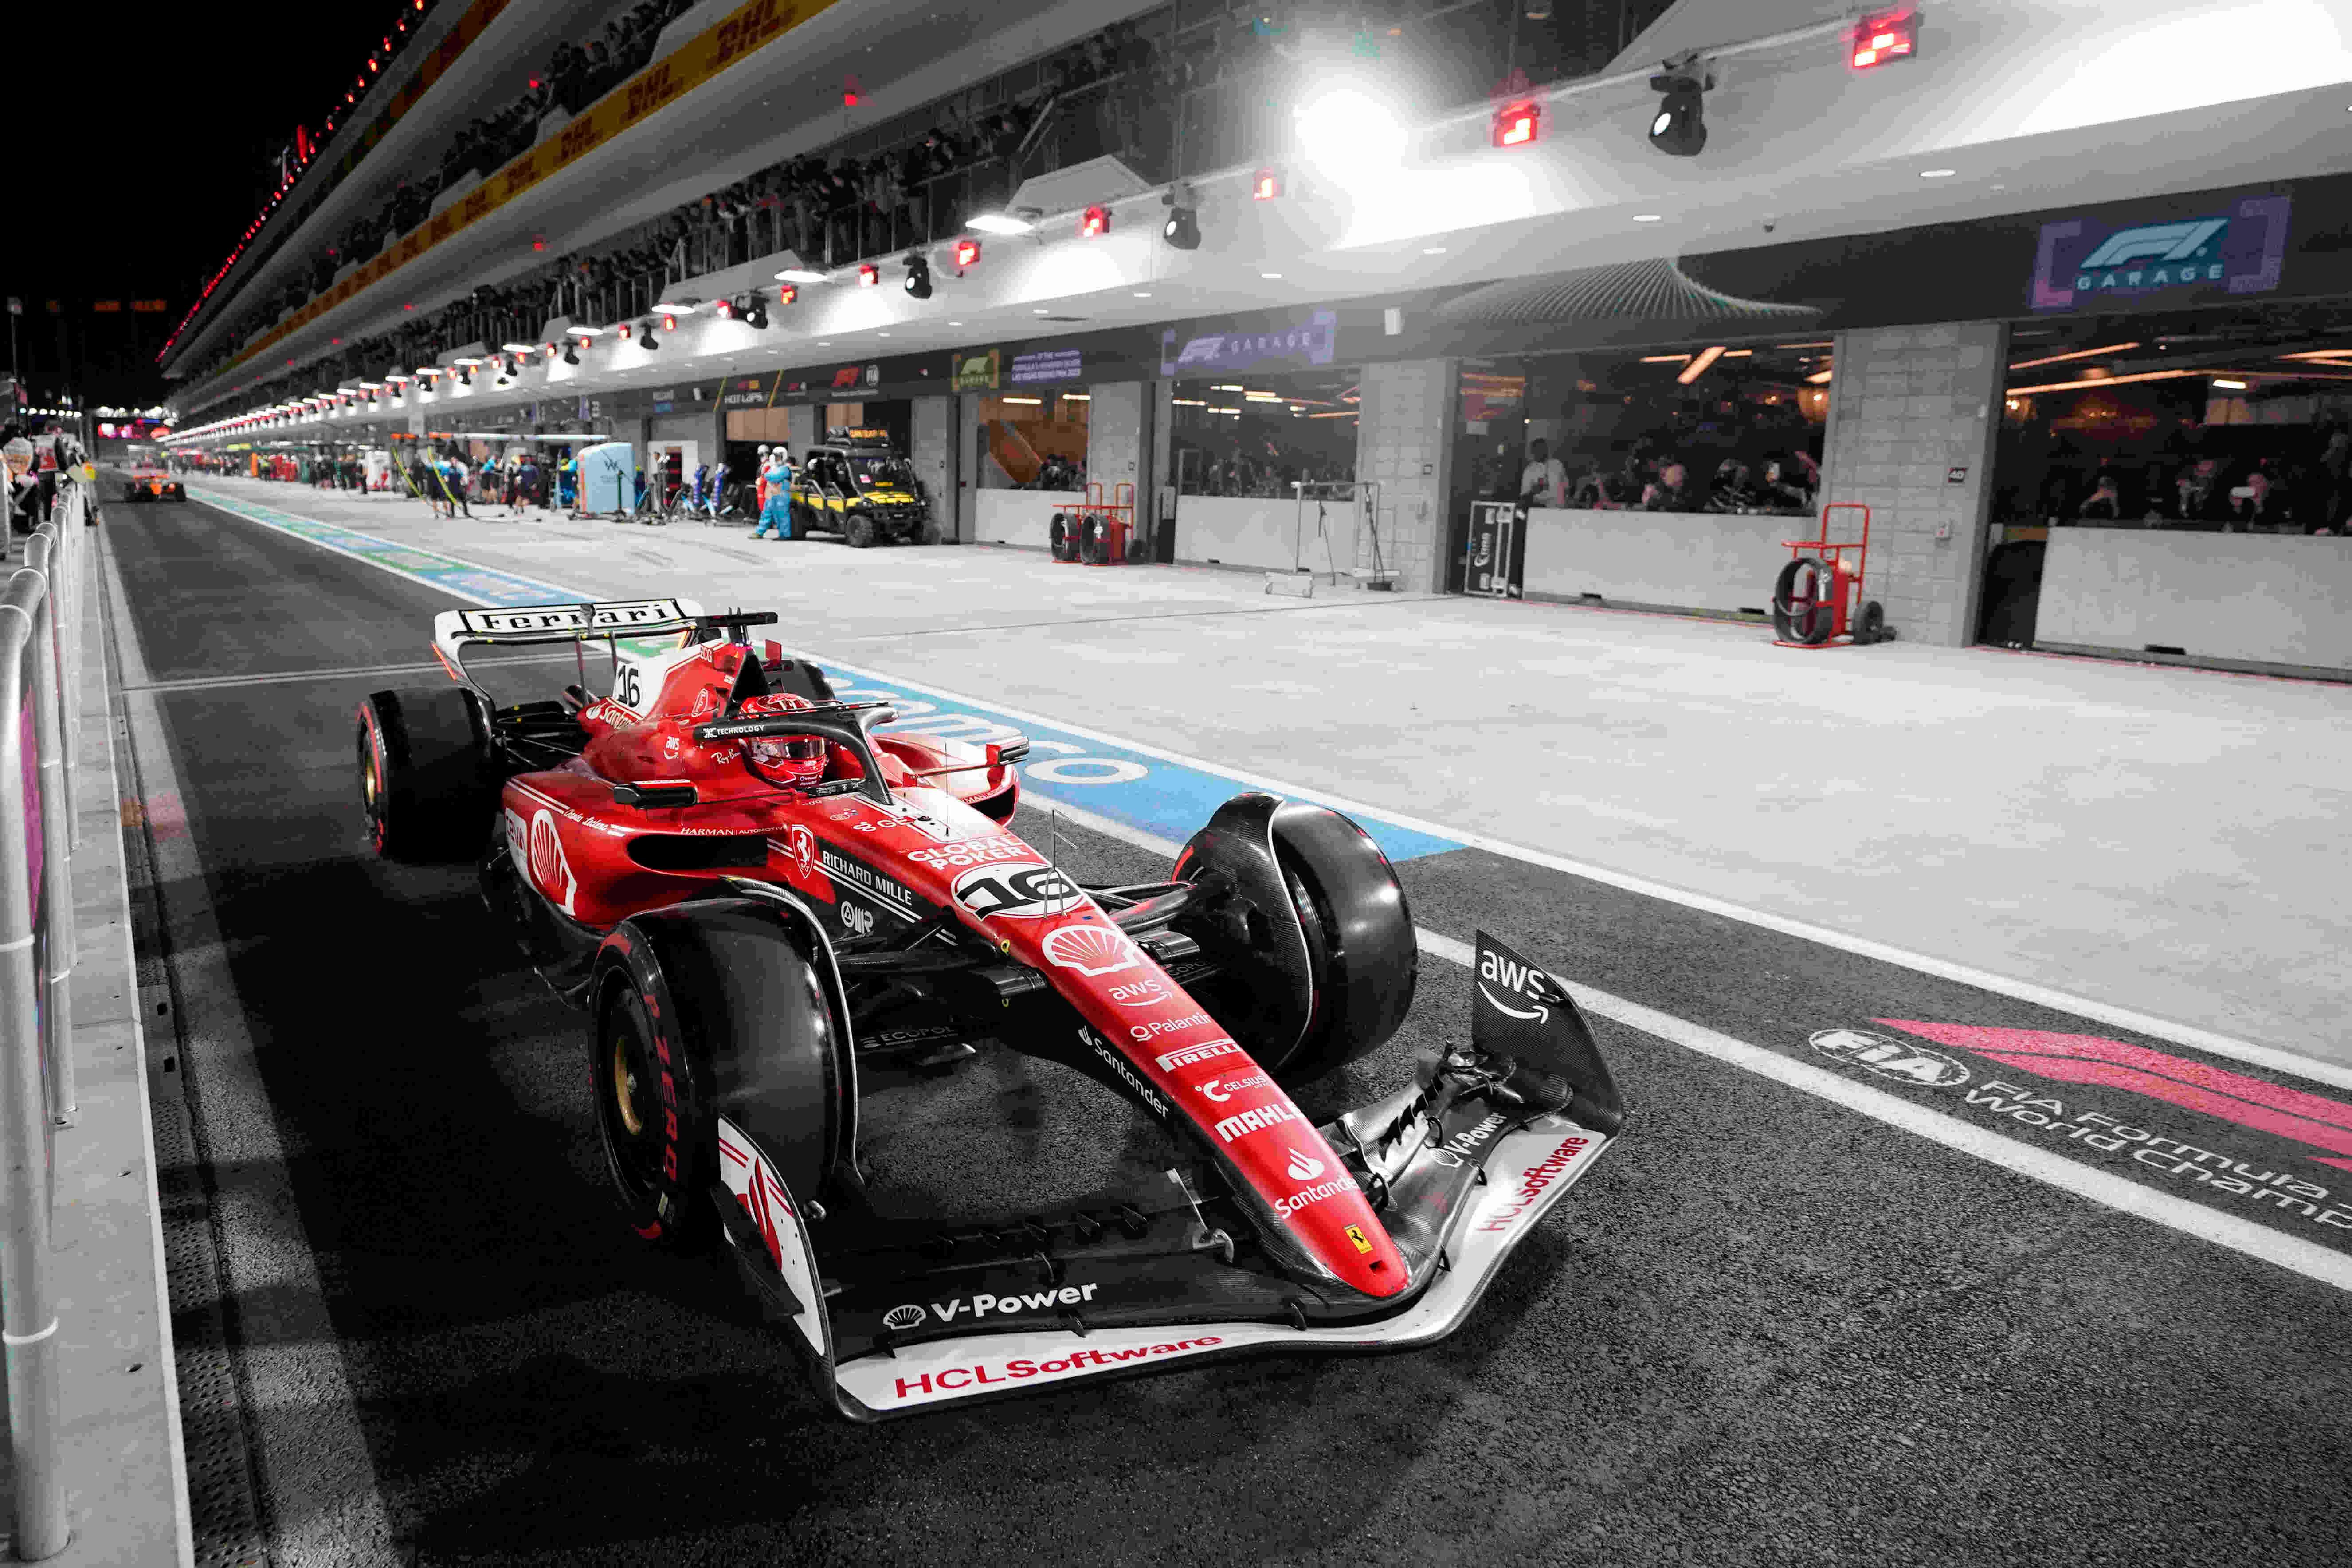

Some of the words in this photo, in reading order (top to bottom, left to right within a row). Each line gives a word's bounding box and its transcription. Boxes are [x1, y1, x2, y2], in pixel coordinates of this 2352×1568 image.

[2077, 265, 2223, 290] GARAGE
[1231, 333, 1310, 355] GARAGE
[617, 664, 640, 708] 16
[666, 736, 680, 750] aws
[717, 725, 764, 736] TECHNOLOGY
[681, 826, 734, 836] HARMAN
[907, 836, 1023, 861] GLOBAL
[930, 847, 1029, 870] POKER
[822, 850, 872, 886] RICHARD
[876, 876, 912, 906] MILLE
[956, 867, 1083, 921] 16
[1109, 978, 1162, 1000] aws
[1481, 949, 1546, 1000] aws
[1148, 1012, 1213, 1035] Palantir
[1094, 1037, 1168, 1119] Santander
[1224, 1075, 1266, 1092] CELSIUS
[1444, 1110, 1508, 1156] V-Power
[1963, 1088, 2128, 1153] World
[1978, 1080, 2064, 1116] FIA
[2074, 1111, 2330, 1199] Formula
[930, 1282, 1099, 1323] V-Power
[895, 1336, 1225, 1399] HCLSoftware
